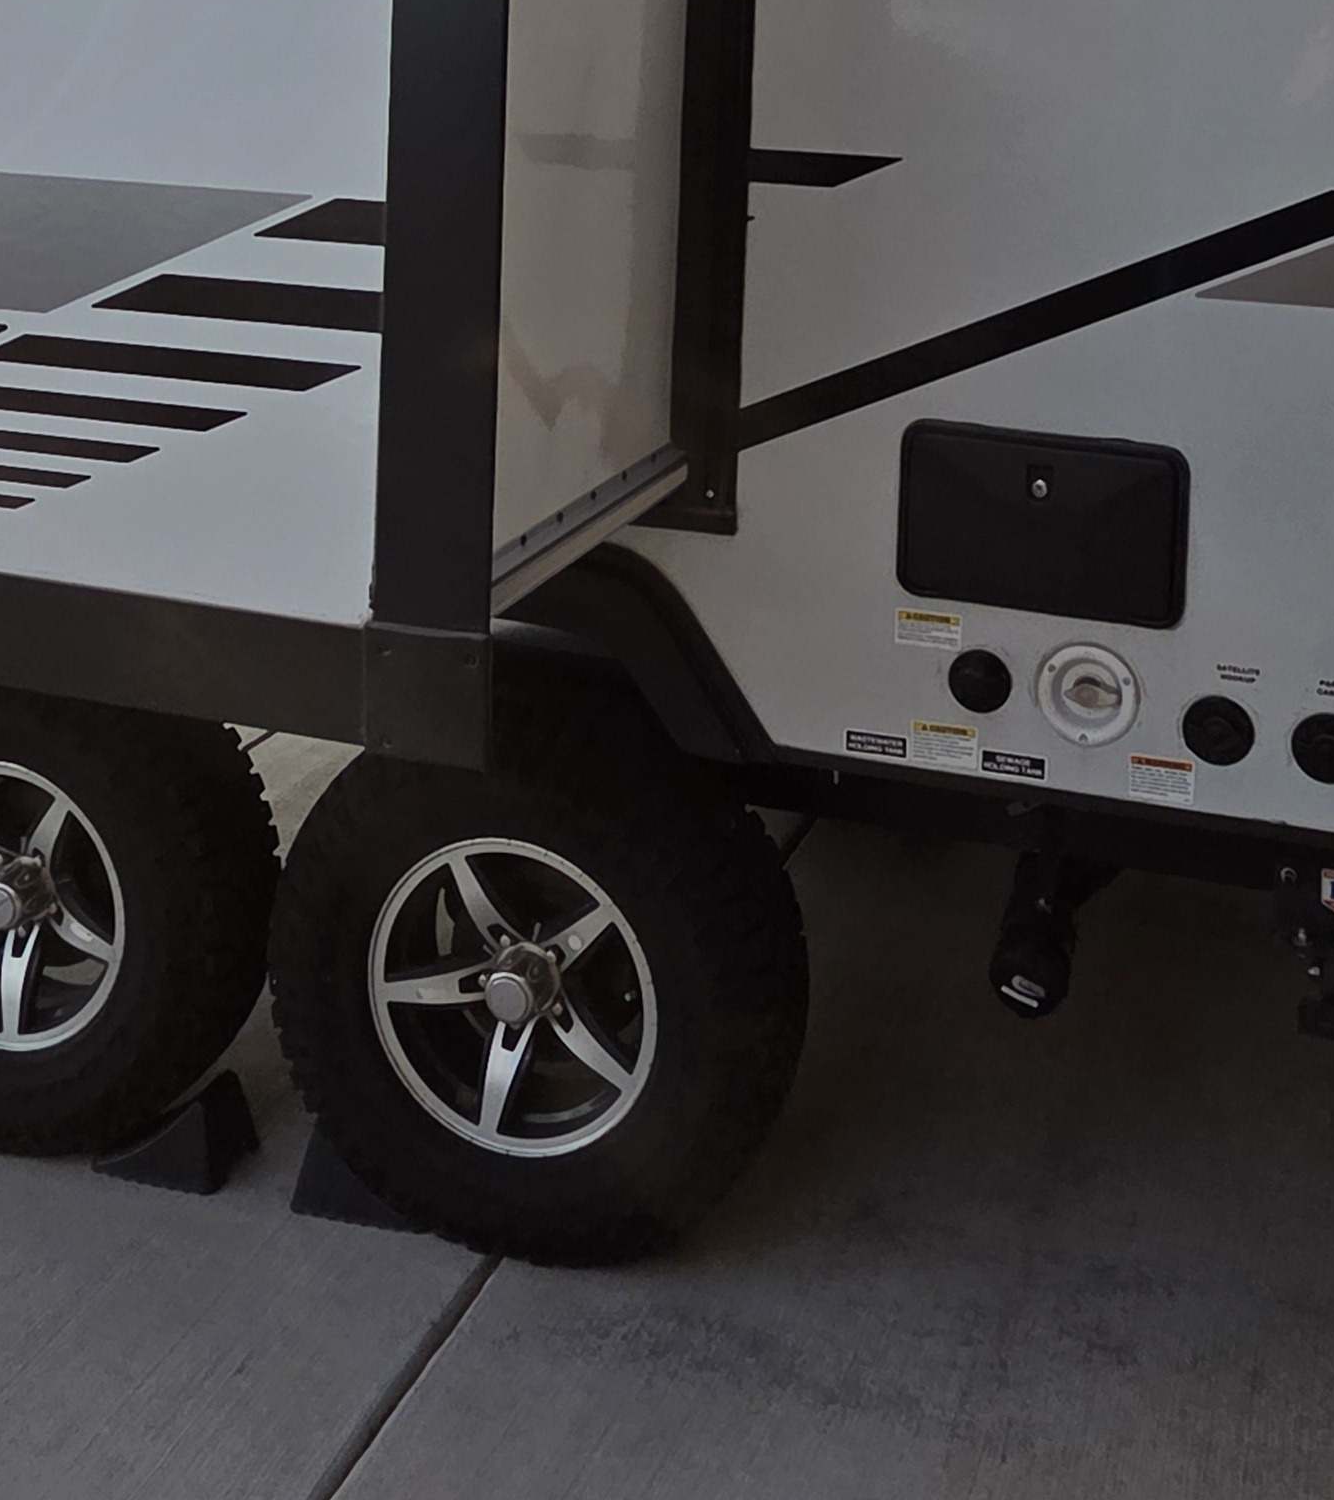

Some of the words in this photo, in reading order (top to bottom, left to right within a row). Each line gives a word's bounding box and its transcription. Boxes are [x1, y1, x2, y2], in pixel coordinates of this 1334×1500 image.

[1217, 664, 1260, 676] SATELLITE
[1220, 673, 1256, 683] HOOKUP
[849, 734, 904, 747] WASTEWATER
[848, 742, 883, 752] HOLDING
[884, 747, 904, 755] TANK
[995, 755, 1031, 766] SEWAGE
[983, 761, 1020, 773] HOLDING
[1021, 766, 1043, 776] TANK
